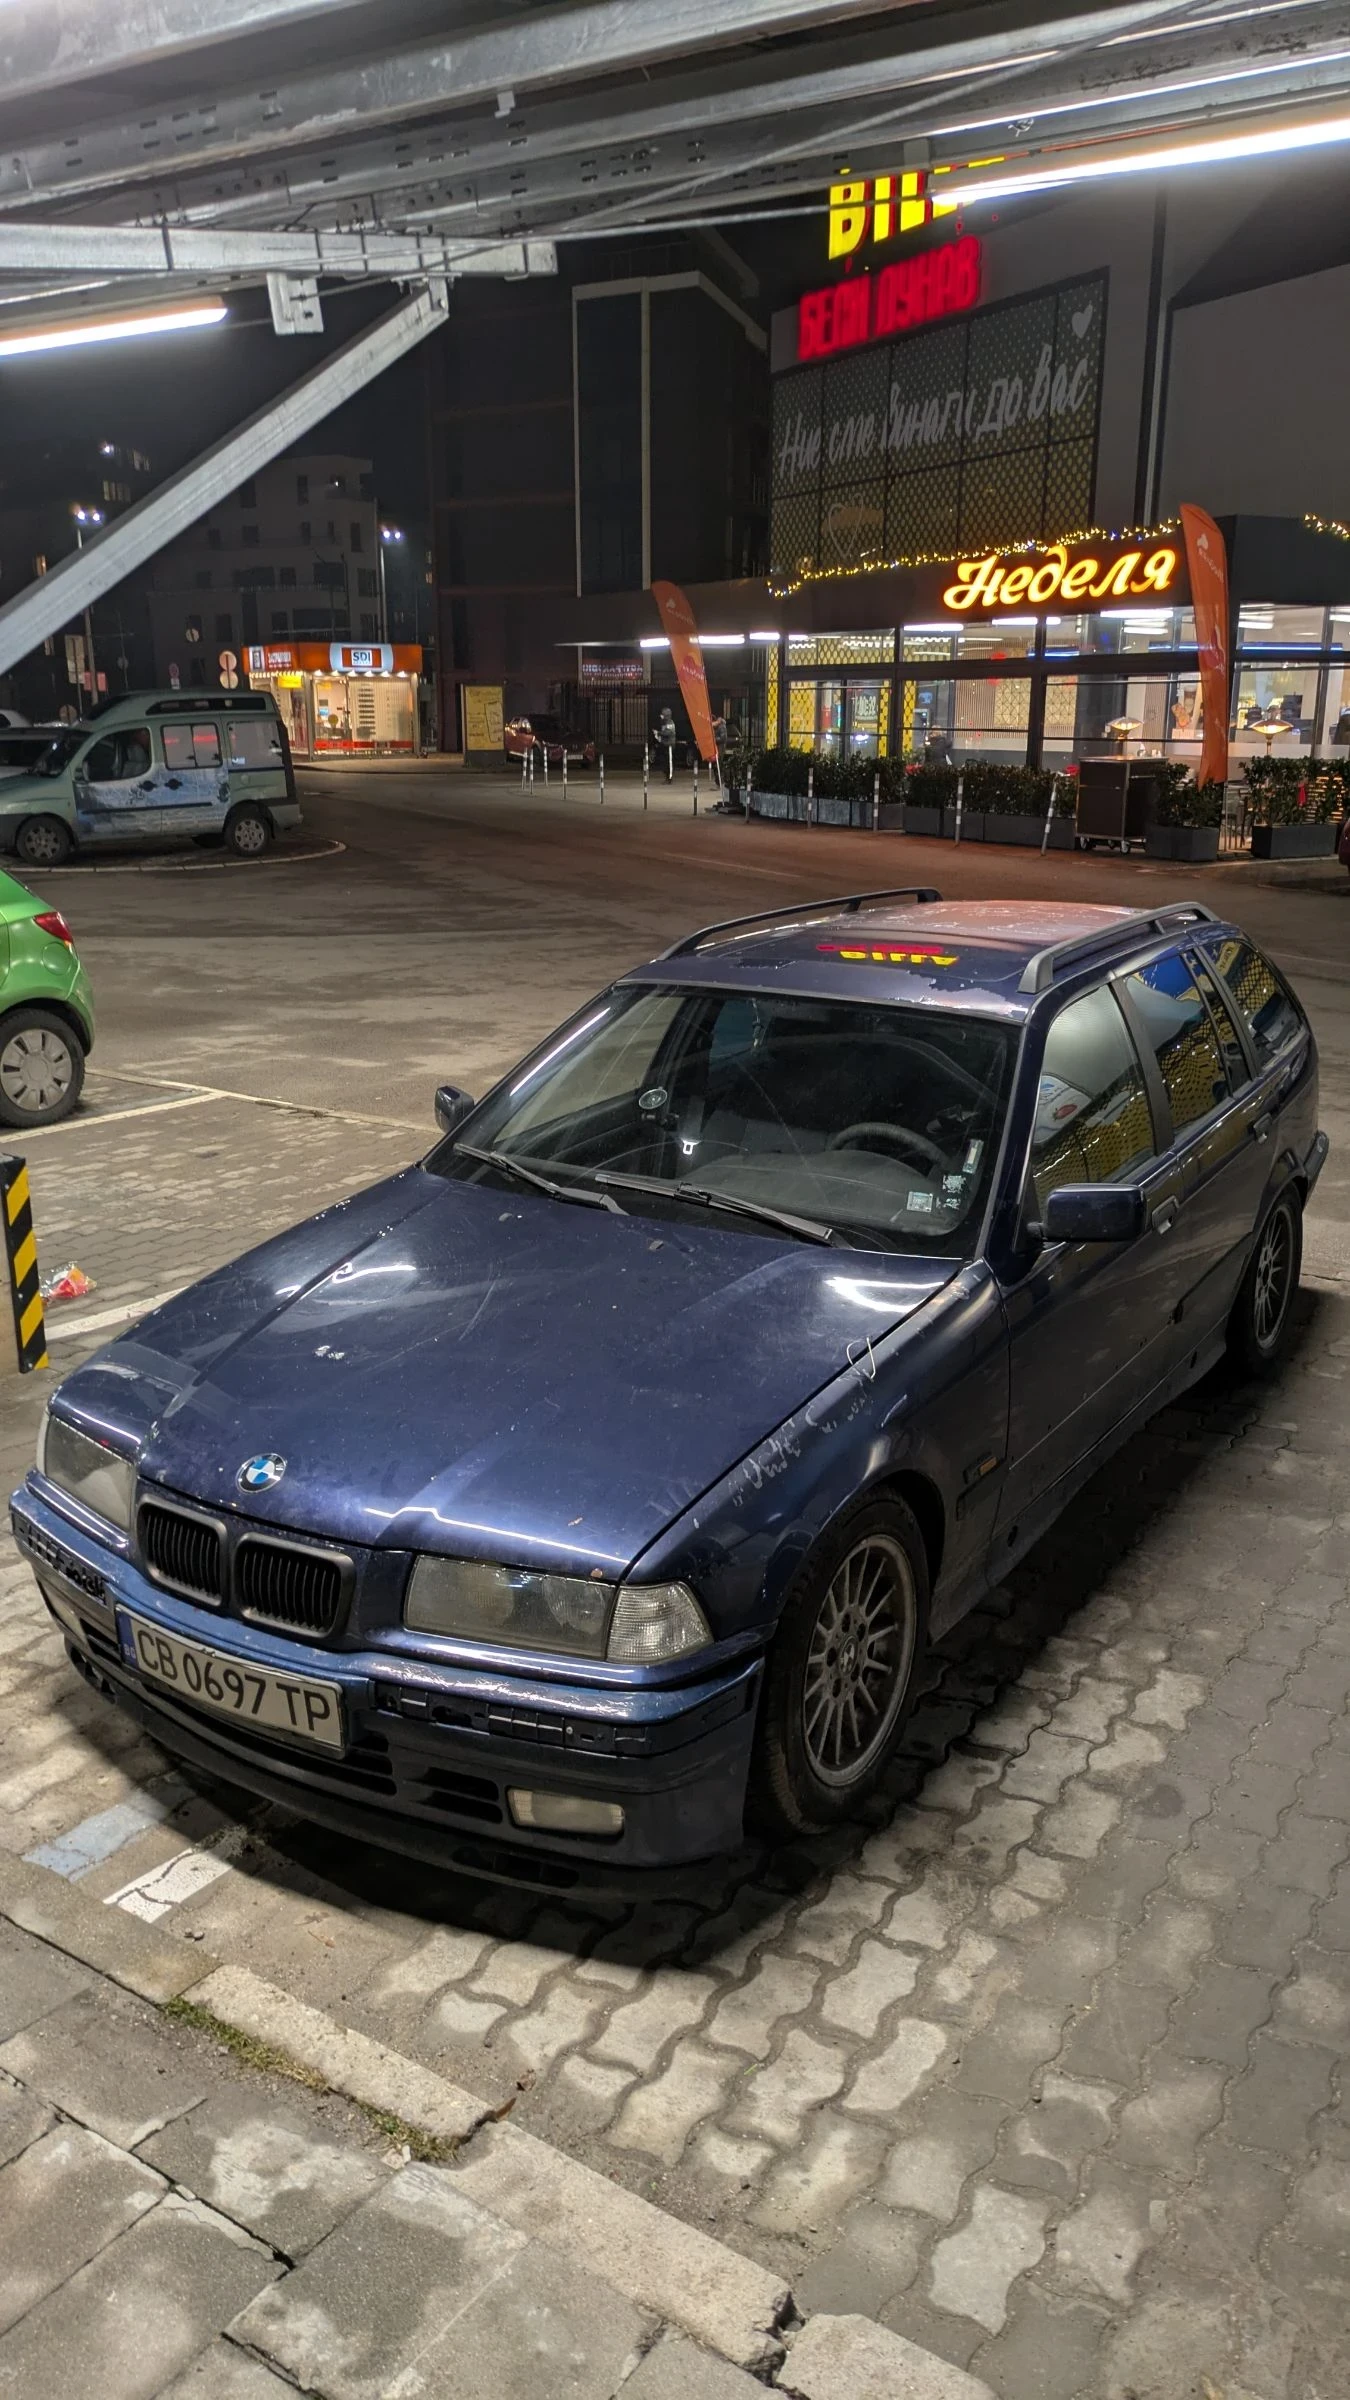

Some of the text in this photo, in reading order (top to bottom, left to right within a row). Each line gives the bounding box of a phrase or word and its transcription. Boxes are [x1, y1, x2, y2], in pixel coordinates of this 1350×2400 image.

[778, 412, 821, 482] Ние
[828, 413, 876, 464] сте
[1027, 343, 1091, 421] Вас
[943, 545, 1176, 609] Неделя
[353, 651, 371, 662] SDI
[137, 1629, 331, 1731] CB 0697 TP
